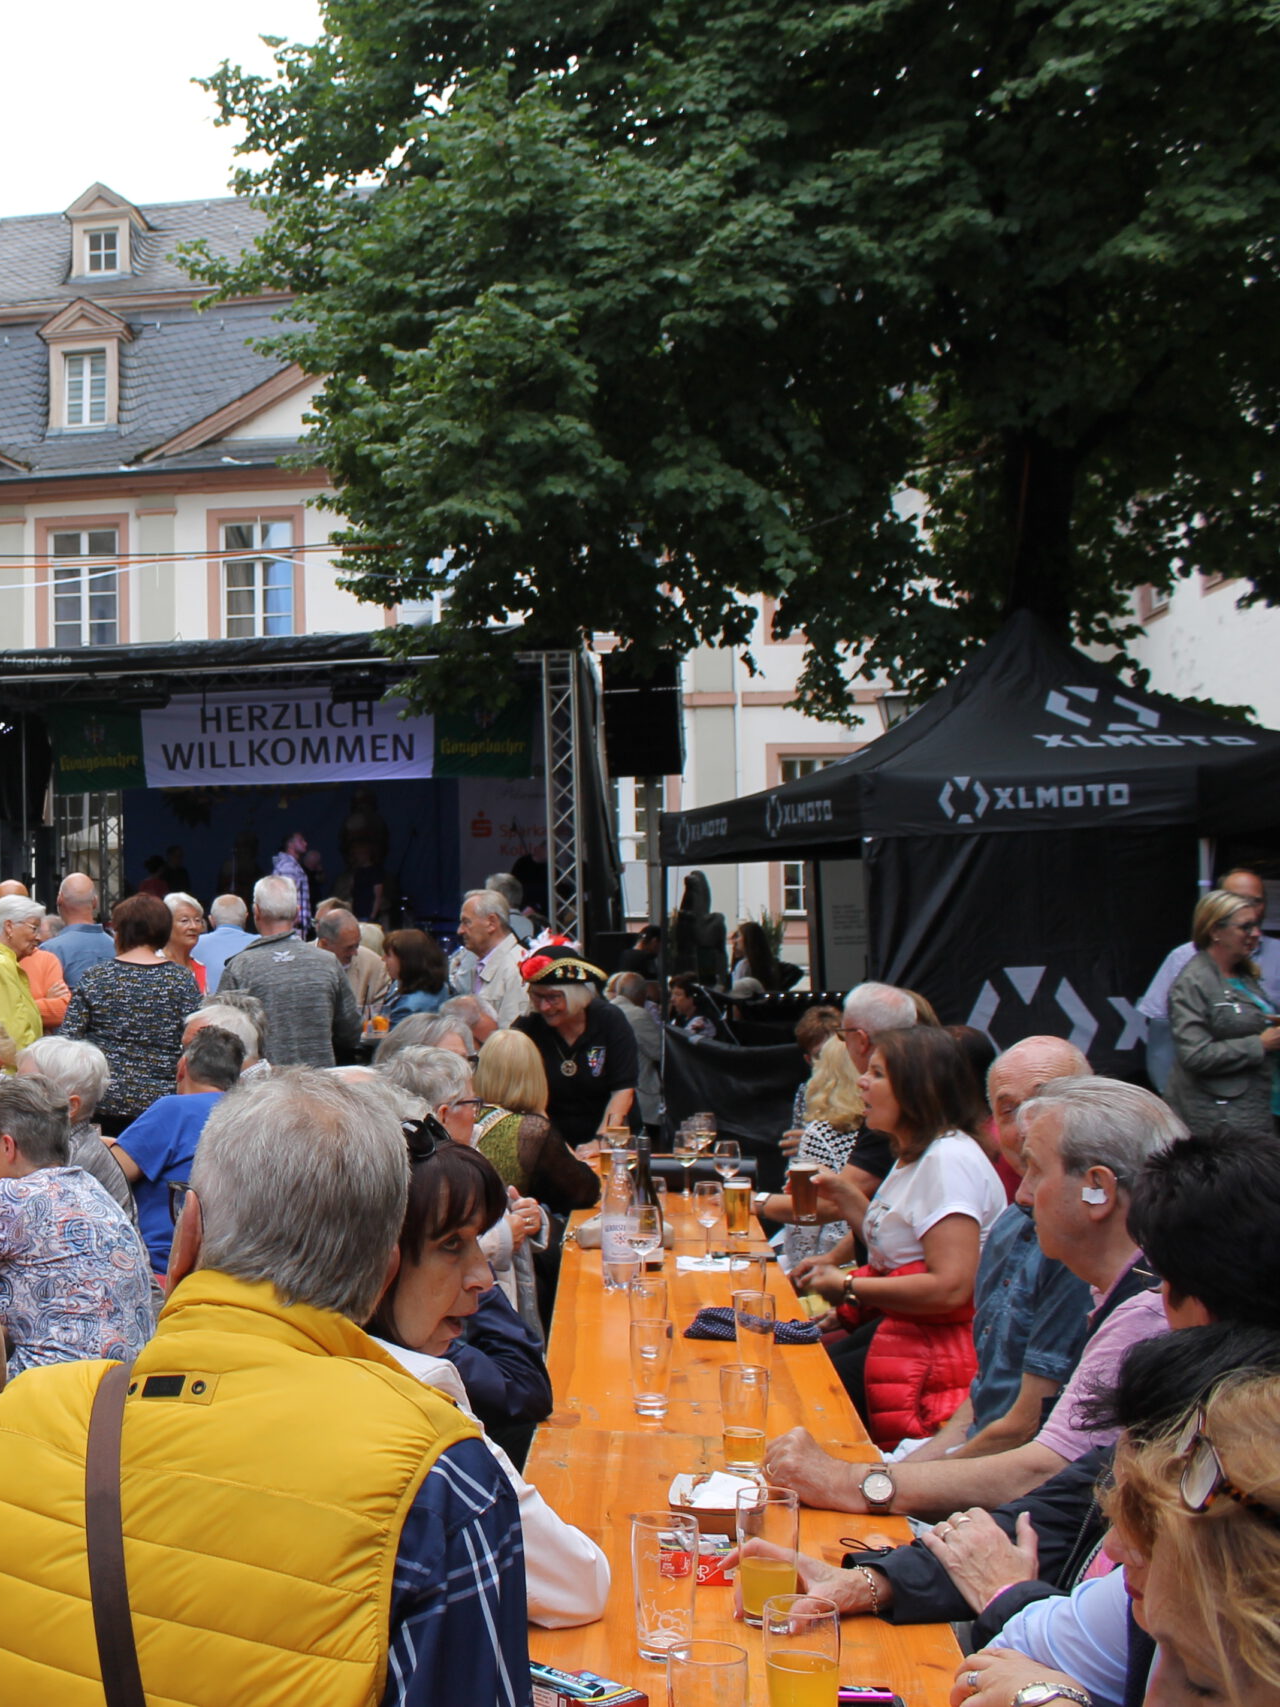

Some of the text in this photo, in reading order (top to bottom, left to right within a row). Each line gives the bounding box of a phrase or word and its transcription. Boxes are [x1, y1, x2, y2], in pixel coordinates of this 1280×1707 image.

[200, 700, 375, 734] HERZLICH
[161, 732, 416, 771] WILLKOMMEN
[1032, 733, 1258, 748] XLMOTO
[993, 782, 1131, 810] XLMOTO
[783, 799, 833, 825] XLMOTO
[690, 817, 728, 842] XLMOTO
